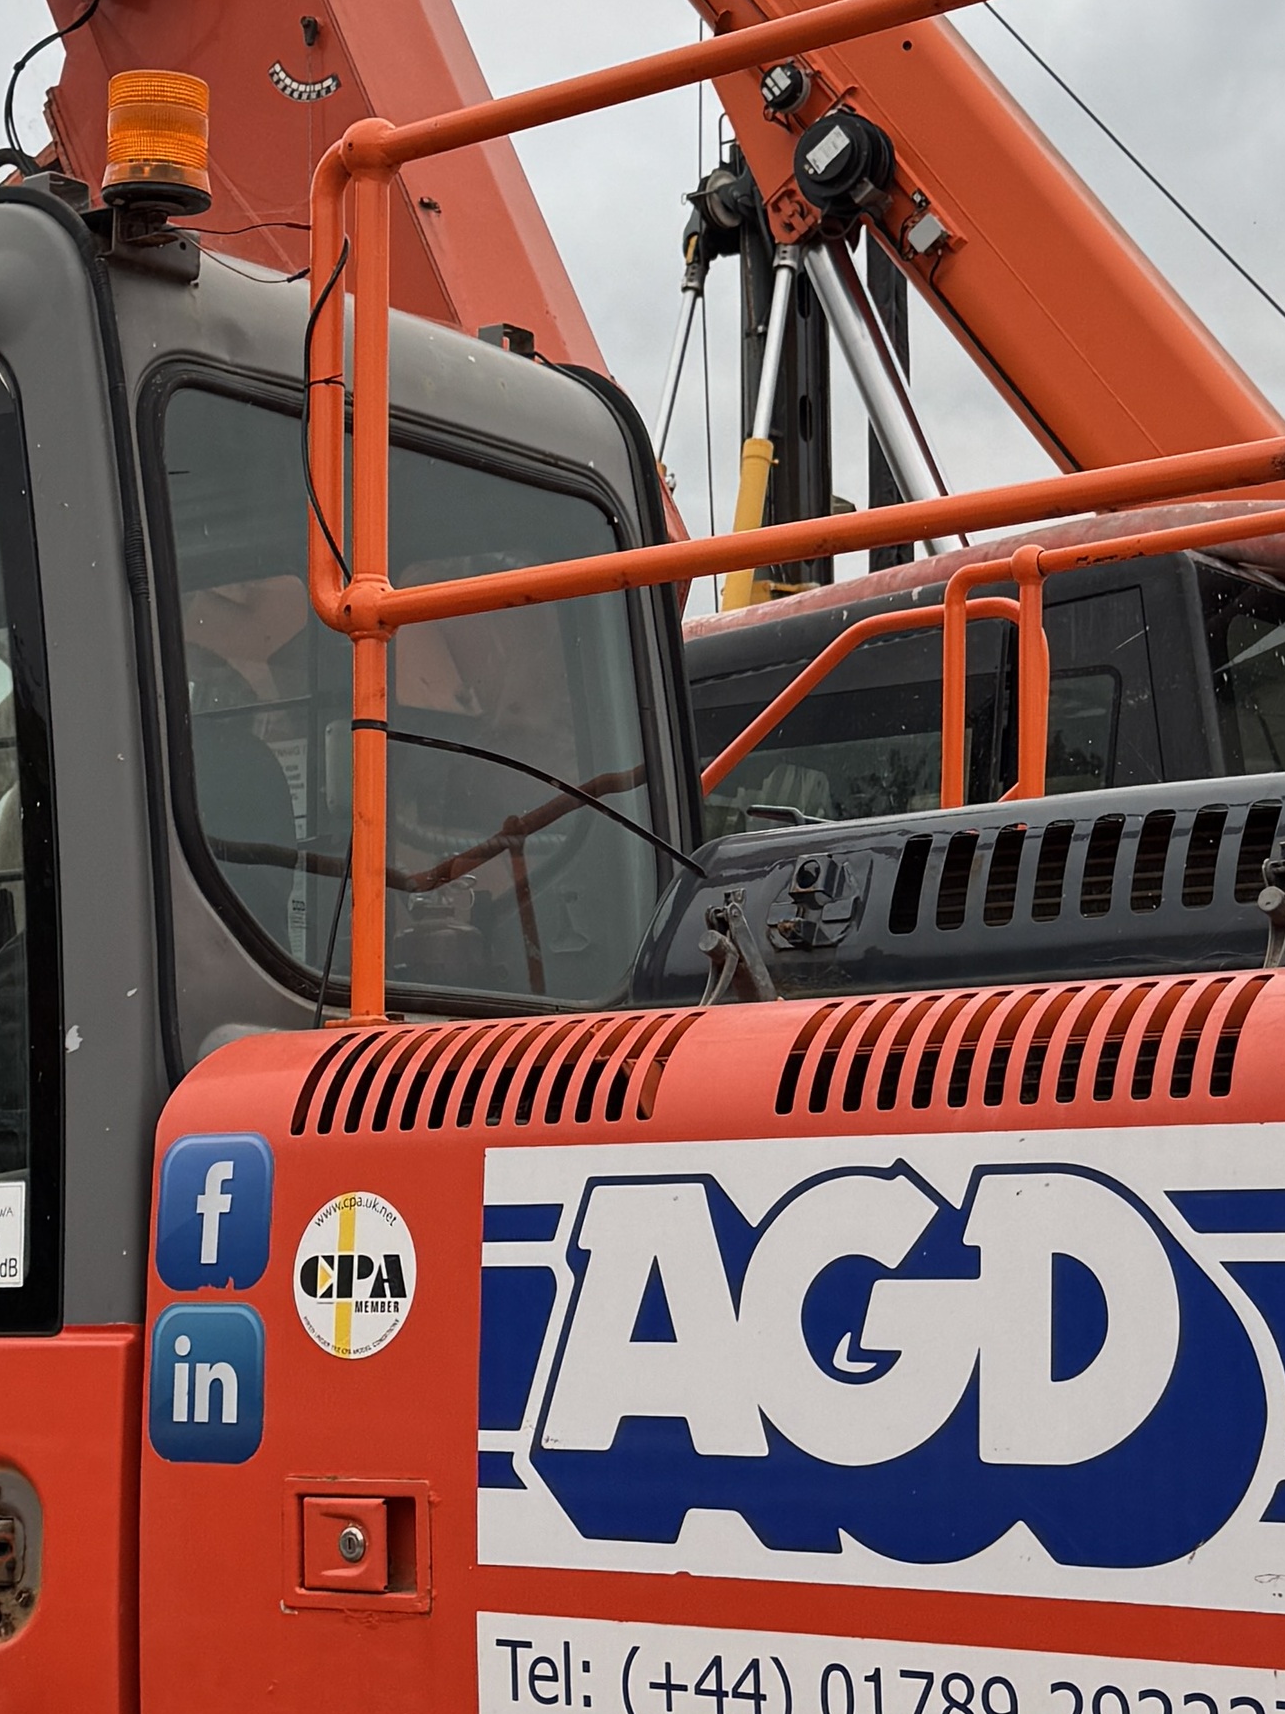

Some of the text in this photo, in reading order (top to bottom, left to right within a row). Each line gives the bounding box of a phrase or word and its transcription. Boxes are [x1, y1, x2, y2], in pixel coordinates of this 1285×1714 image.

[195, 1160, 235, 1265] f
[315, 1195, 397, 1227] www.cpa.uk.net
[0, 1257, 18, 1278] dB
[300, 1254, 407, 1299] CPA
[354, 1300, 400, 1313] MEMBER
[538, 1165, 1185, 1471] AGD
[171, 1334, 238, 1425] in
[496, 1638, 594, 1709] Tel:
